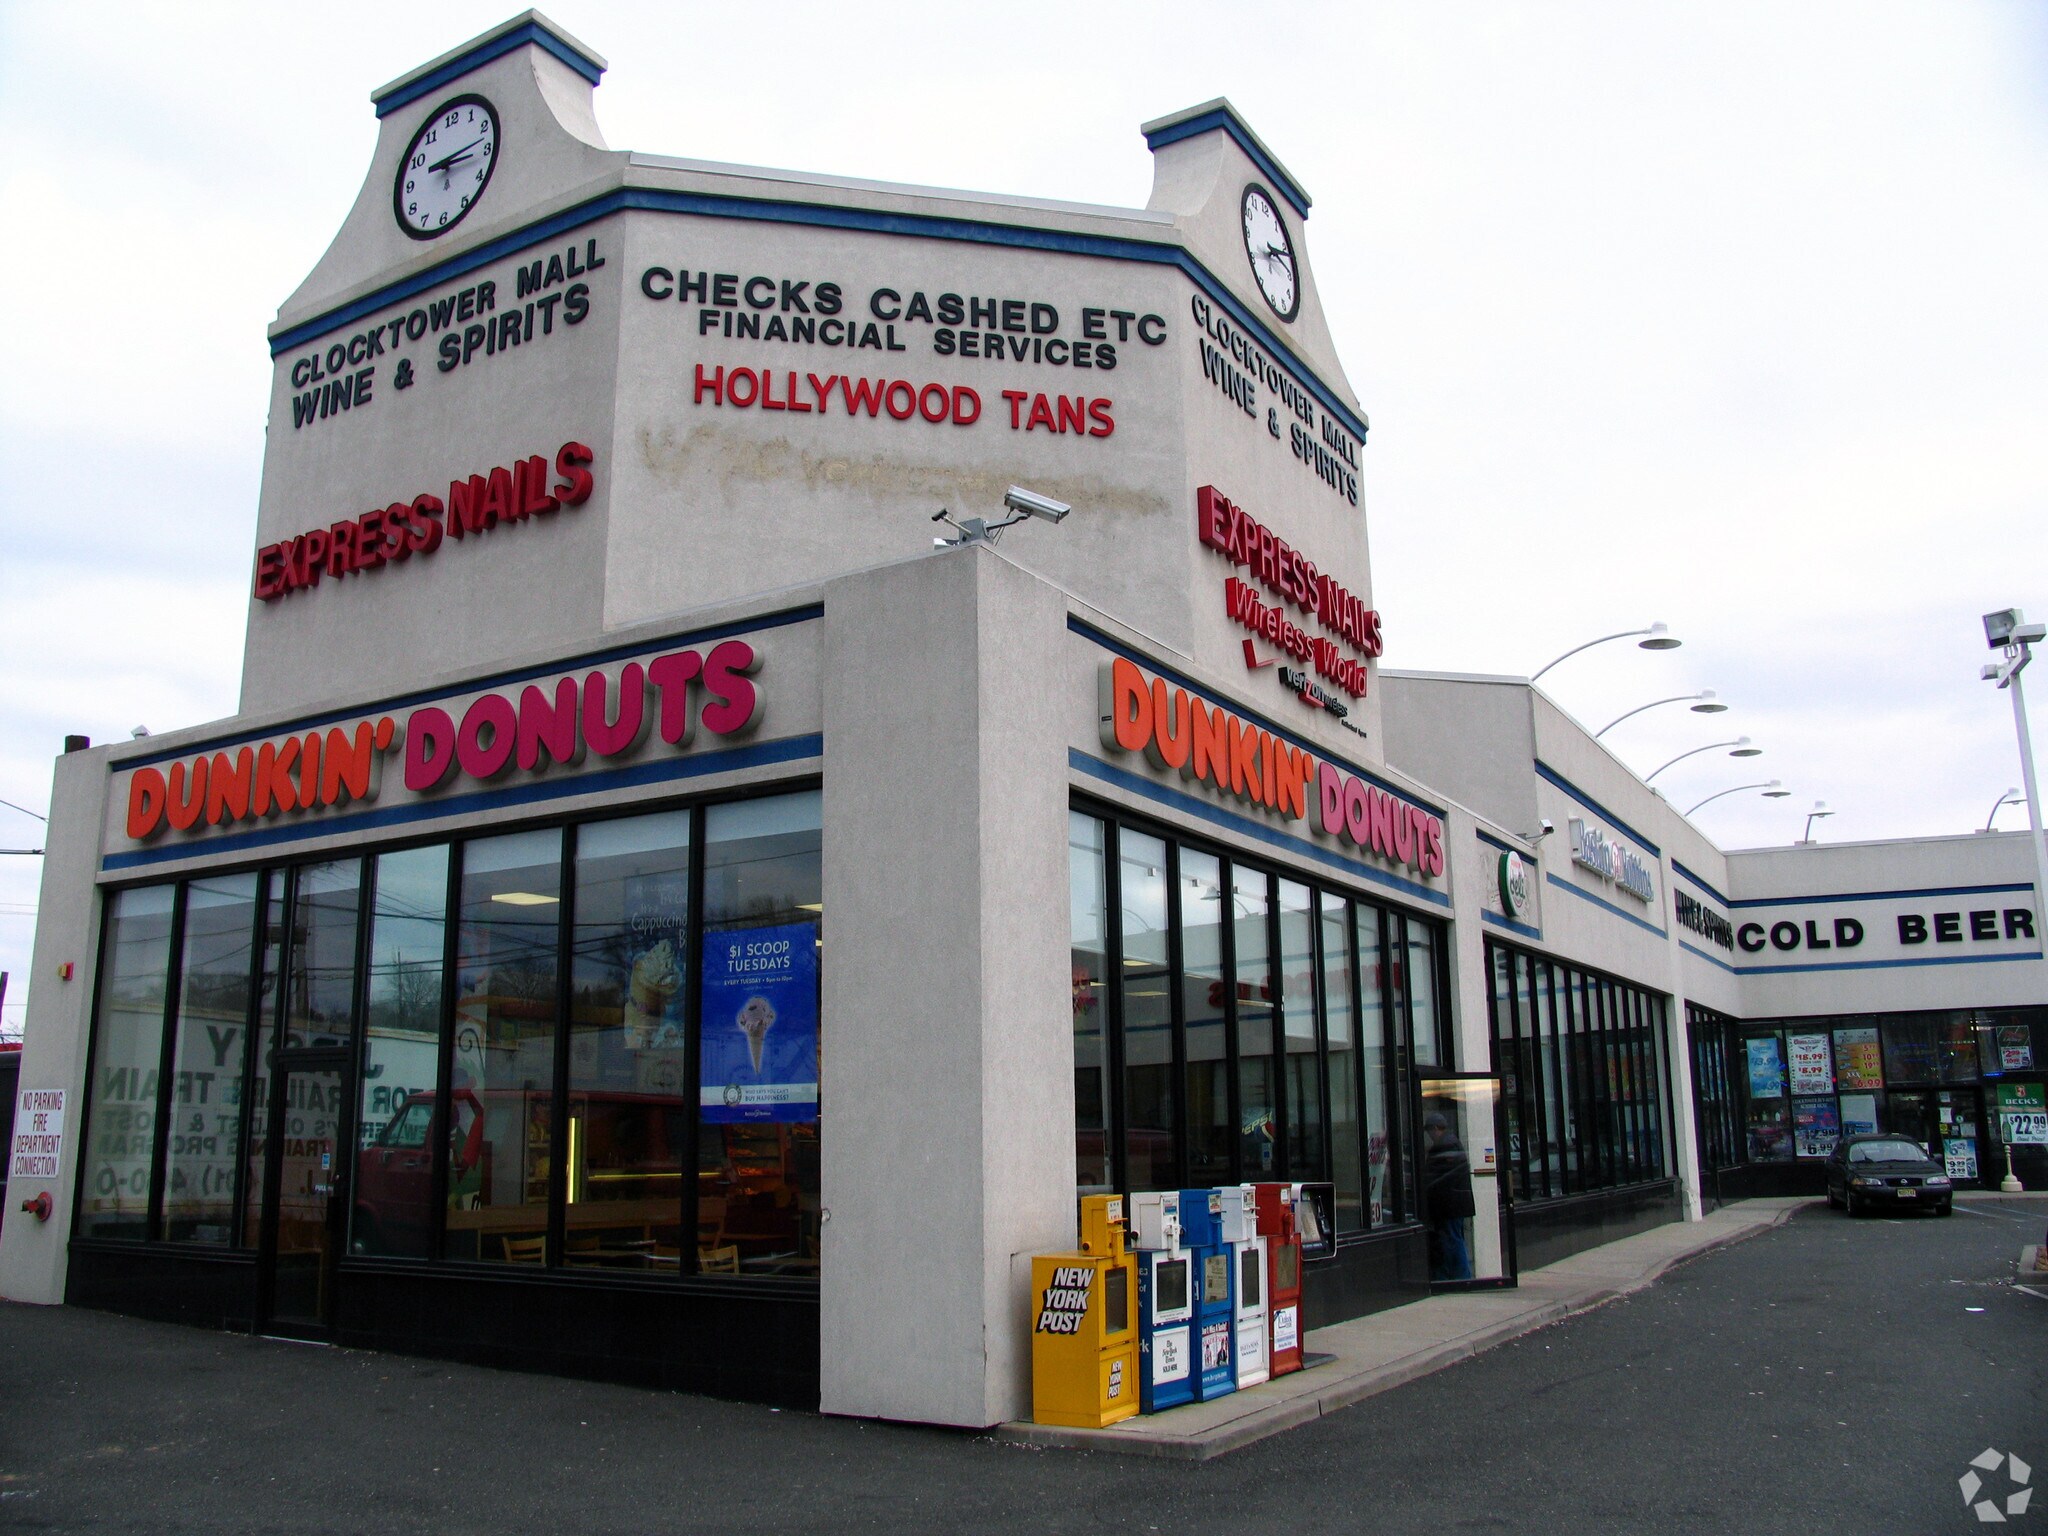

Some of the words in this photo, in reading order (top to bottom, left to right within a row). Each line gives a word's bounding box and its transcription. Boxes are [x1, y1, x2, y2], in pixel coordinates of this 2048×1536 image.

[445, 112, 459, 129] 12
[467, 109, 474, 123] 1
[480, 120, 489, 134] 2
[425, 129, 437, 145] 11
[483, 142, 491, 156] 3
[411, 153, 426, 170] 10
[475, 168, 484, 182] 4
[406, 181, 415, 194] 9
[408, 202, 417, 215] 8
[460, 194, 469, 209] 5
[1261, 201, 1269, 218] 12
[420, 213, 430, 227] 7
[439, 211, 448, 225] 6
[291, 280, 496, 388] CLOCKTOWER
[516, 238, 606, 300] MALL
[640, 266, 843, 316] CHECKS
[869, 287, 1060, 336] CASHED
[1082, 307, 1168, 346] ETC
[698, 309, 906, 352] FINANCIAL
[933, 327, 1118, 371] SERVICES
[292, 366, 375, 429] WINE
[394, 358, 414, 390] &
[437, 282, 591, 373] SPIRITS
[1191, 293, 1314, 429] CLOCKTOWER
[1321, 413, 1359, 471] MALL
[694, 363, 982, 426] HOLLYWOOD
[1001, 389, 1116, 438] TANS
[1199, 337, 1257, 419] WINE
[1267, 407, 1281, 440] &
[1290, 421, 1359, 507] SPIRITS
[253, 493, 444, 602] EXPRESS
[446, 441, 594, 540] NAILS
[1197, 484, 1320, 615] EXPRESS
[1317, 574, 1383, 658] NAILS
[1225, 576, 1315, 663] Wireless
[1314, 637, 1367, 698] World
[126, 716, 395, 840] DUNKIN'
[404, 640, 758, 791] DONUTS
[1112, 657, 1314, 820] DUNKIN'
[1319, 761, 1443, 877] DONUTS
[631, 912, 687, 935] Cappuccino
[1737, 917, 1864, 952] COLD
[1897, 908, 2035, 944] BEER
[747, 940, 789, 956] SCOOP
[728, 956, 790, 972] TUESDAYS
[23, 1092, 32, 1111] NO
[34, 1091, 63, 1111] PARKING
[2005, 1097, 2038, 1105] BECK'S
[33, 1114, 48, 1131] FIRE
[16, 1135, 60, 1153] DEPARTMENT
[15, 1156, 57, 1175] CONNECTION
[1053, 1267, 1094, 1289] NEW
[1044, 1289, 1090, 1311] YORK
[1037, 1311, 1084, 1334] POST
[1112, 1360, 1122, 1372] NEW
[1108, 1384, 1120, 1399] POST
